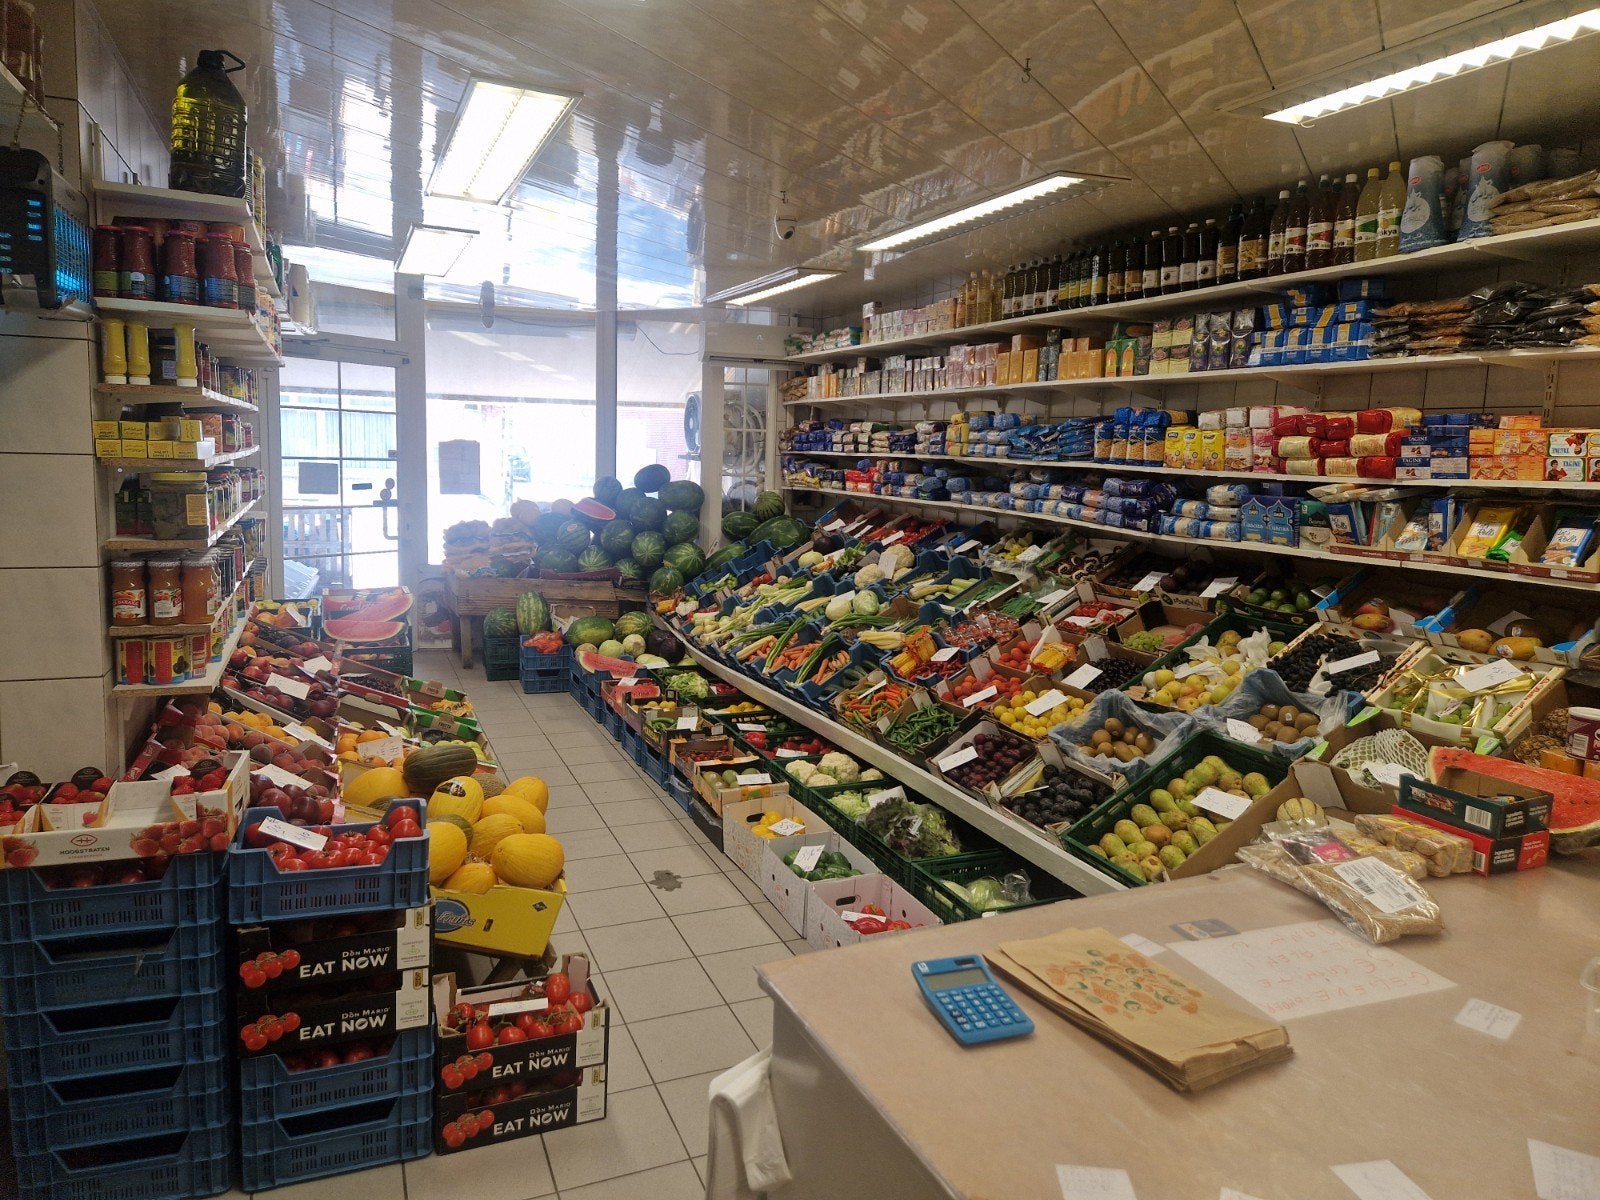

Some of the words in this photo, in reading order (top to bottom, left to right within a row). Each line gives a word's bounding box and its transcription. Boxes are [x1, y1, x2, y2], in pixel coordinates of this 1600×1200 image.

[59, 846, 110, 855] HOOGSTRATEN
[299, 961, 336, 978] EAT
[342, 953, 388, 972] NOW
[299, 1023, 336, 1041] EAT
[341, 1014, 387, 1033] NOW
[492, 1062, 524, 1078] EAT
[528, 1053, 569, 1071] NOW
[493, 1118, 525, 1136] EAT
[529, 1109, 570, 1128] NOW
